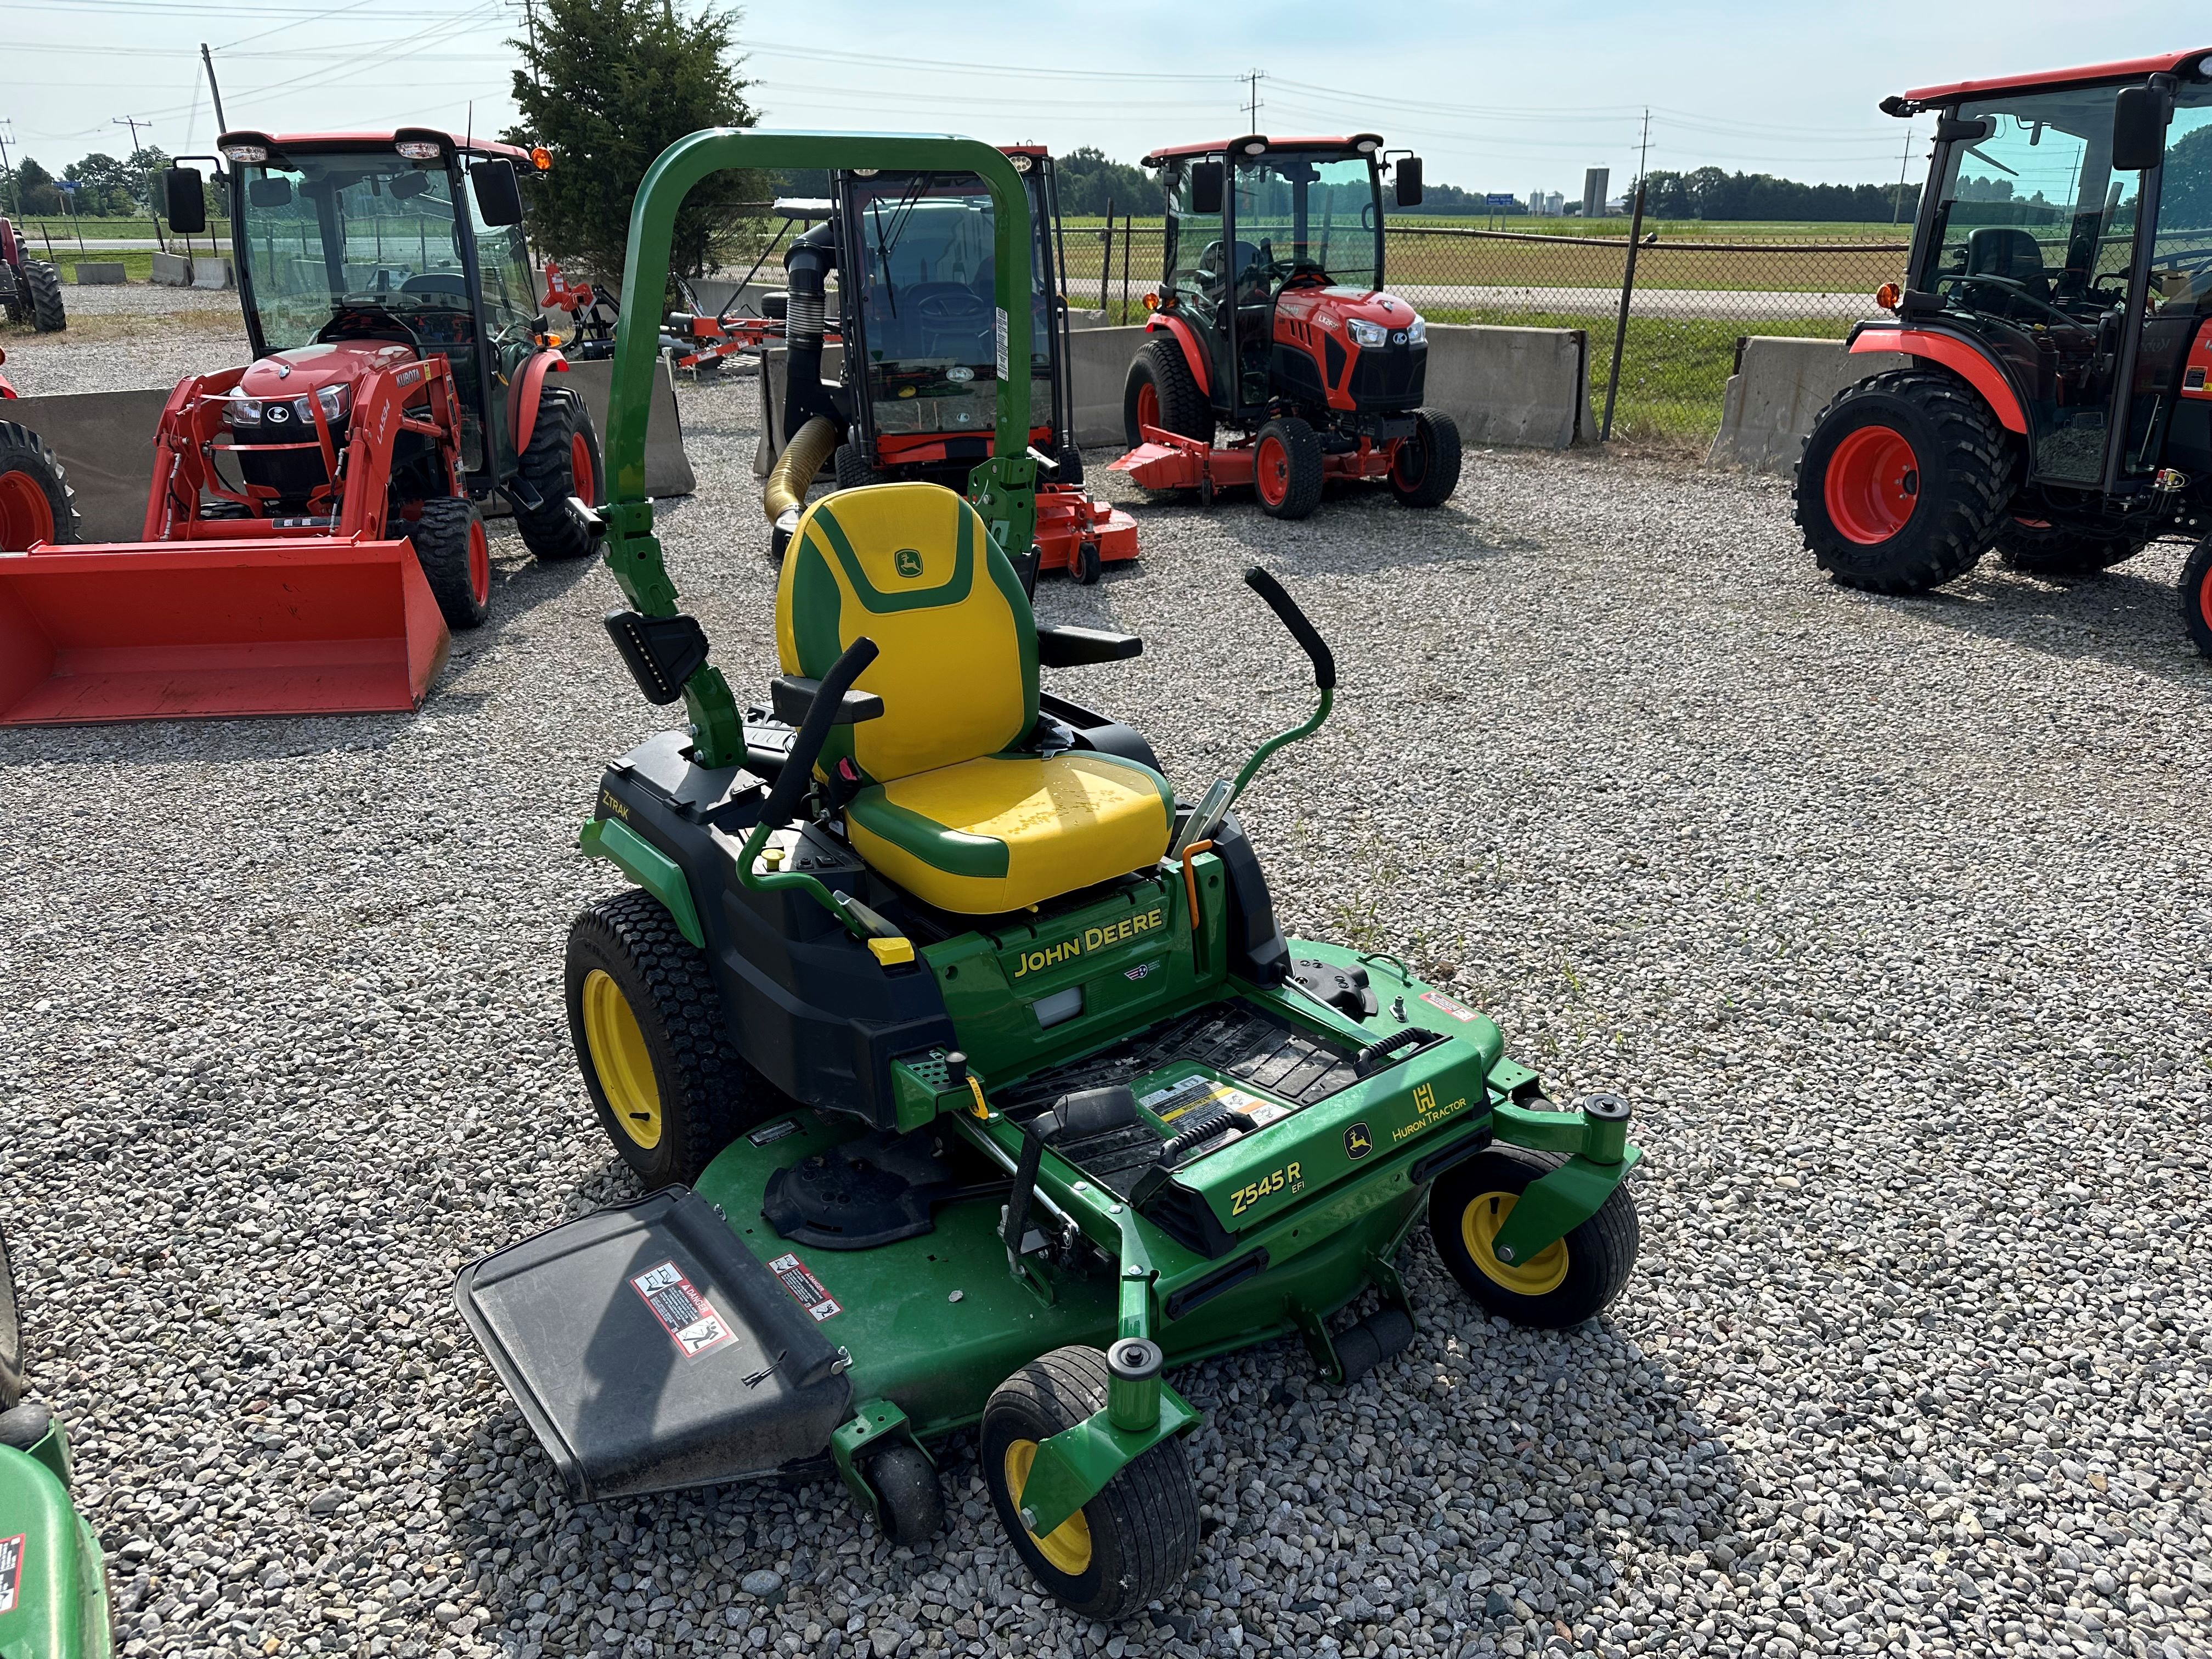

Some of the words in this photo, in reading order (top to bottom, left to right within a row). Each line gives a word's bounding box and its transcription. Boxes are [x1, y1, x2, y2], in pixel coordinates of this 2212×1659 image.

[396, 369, 421, 387] KUBOTA
[377, 398, 390, 445] LA534
[602, 789, 630, 820] ZTRAK
[1014, 937, 1081, 979] JOHN
[1084, 908, 1164, 951] DEERE
[1392, 1116, 1427, 1142] HURON
[1426, 1097, 1466, 1124] TRACTOR
[1230, 1169, 1285, 1216] Z545
[1288, 1161, 1302, 1184] R
[1291, 1180, 1305, 1194] EFI
[809, 1275, 824, 1293] DANGER
[686, 1288, 709, 1313] DANGER
